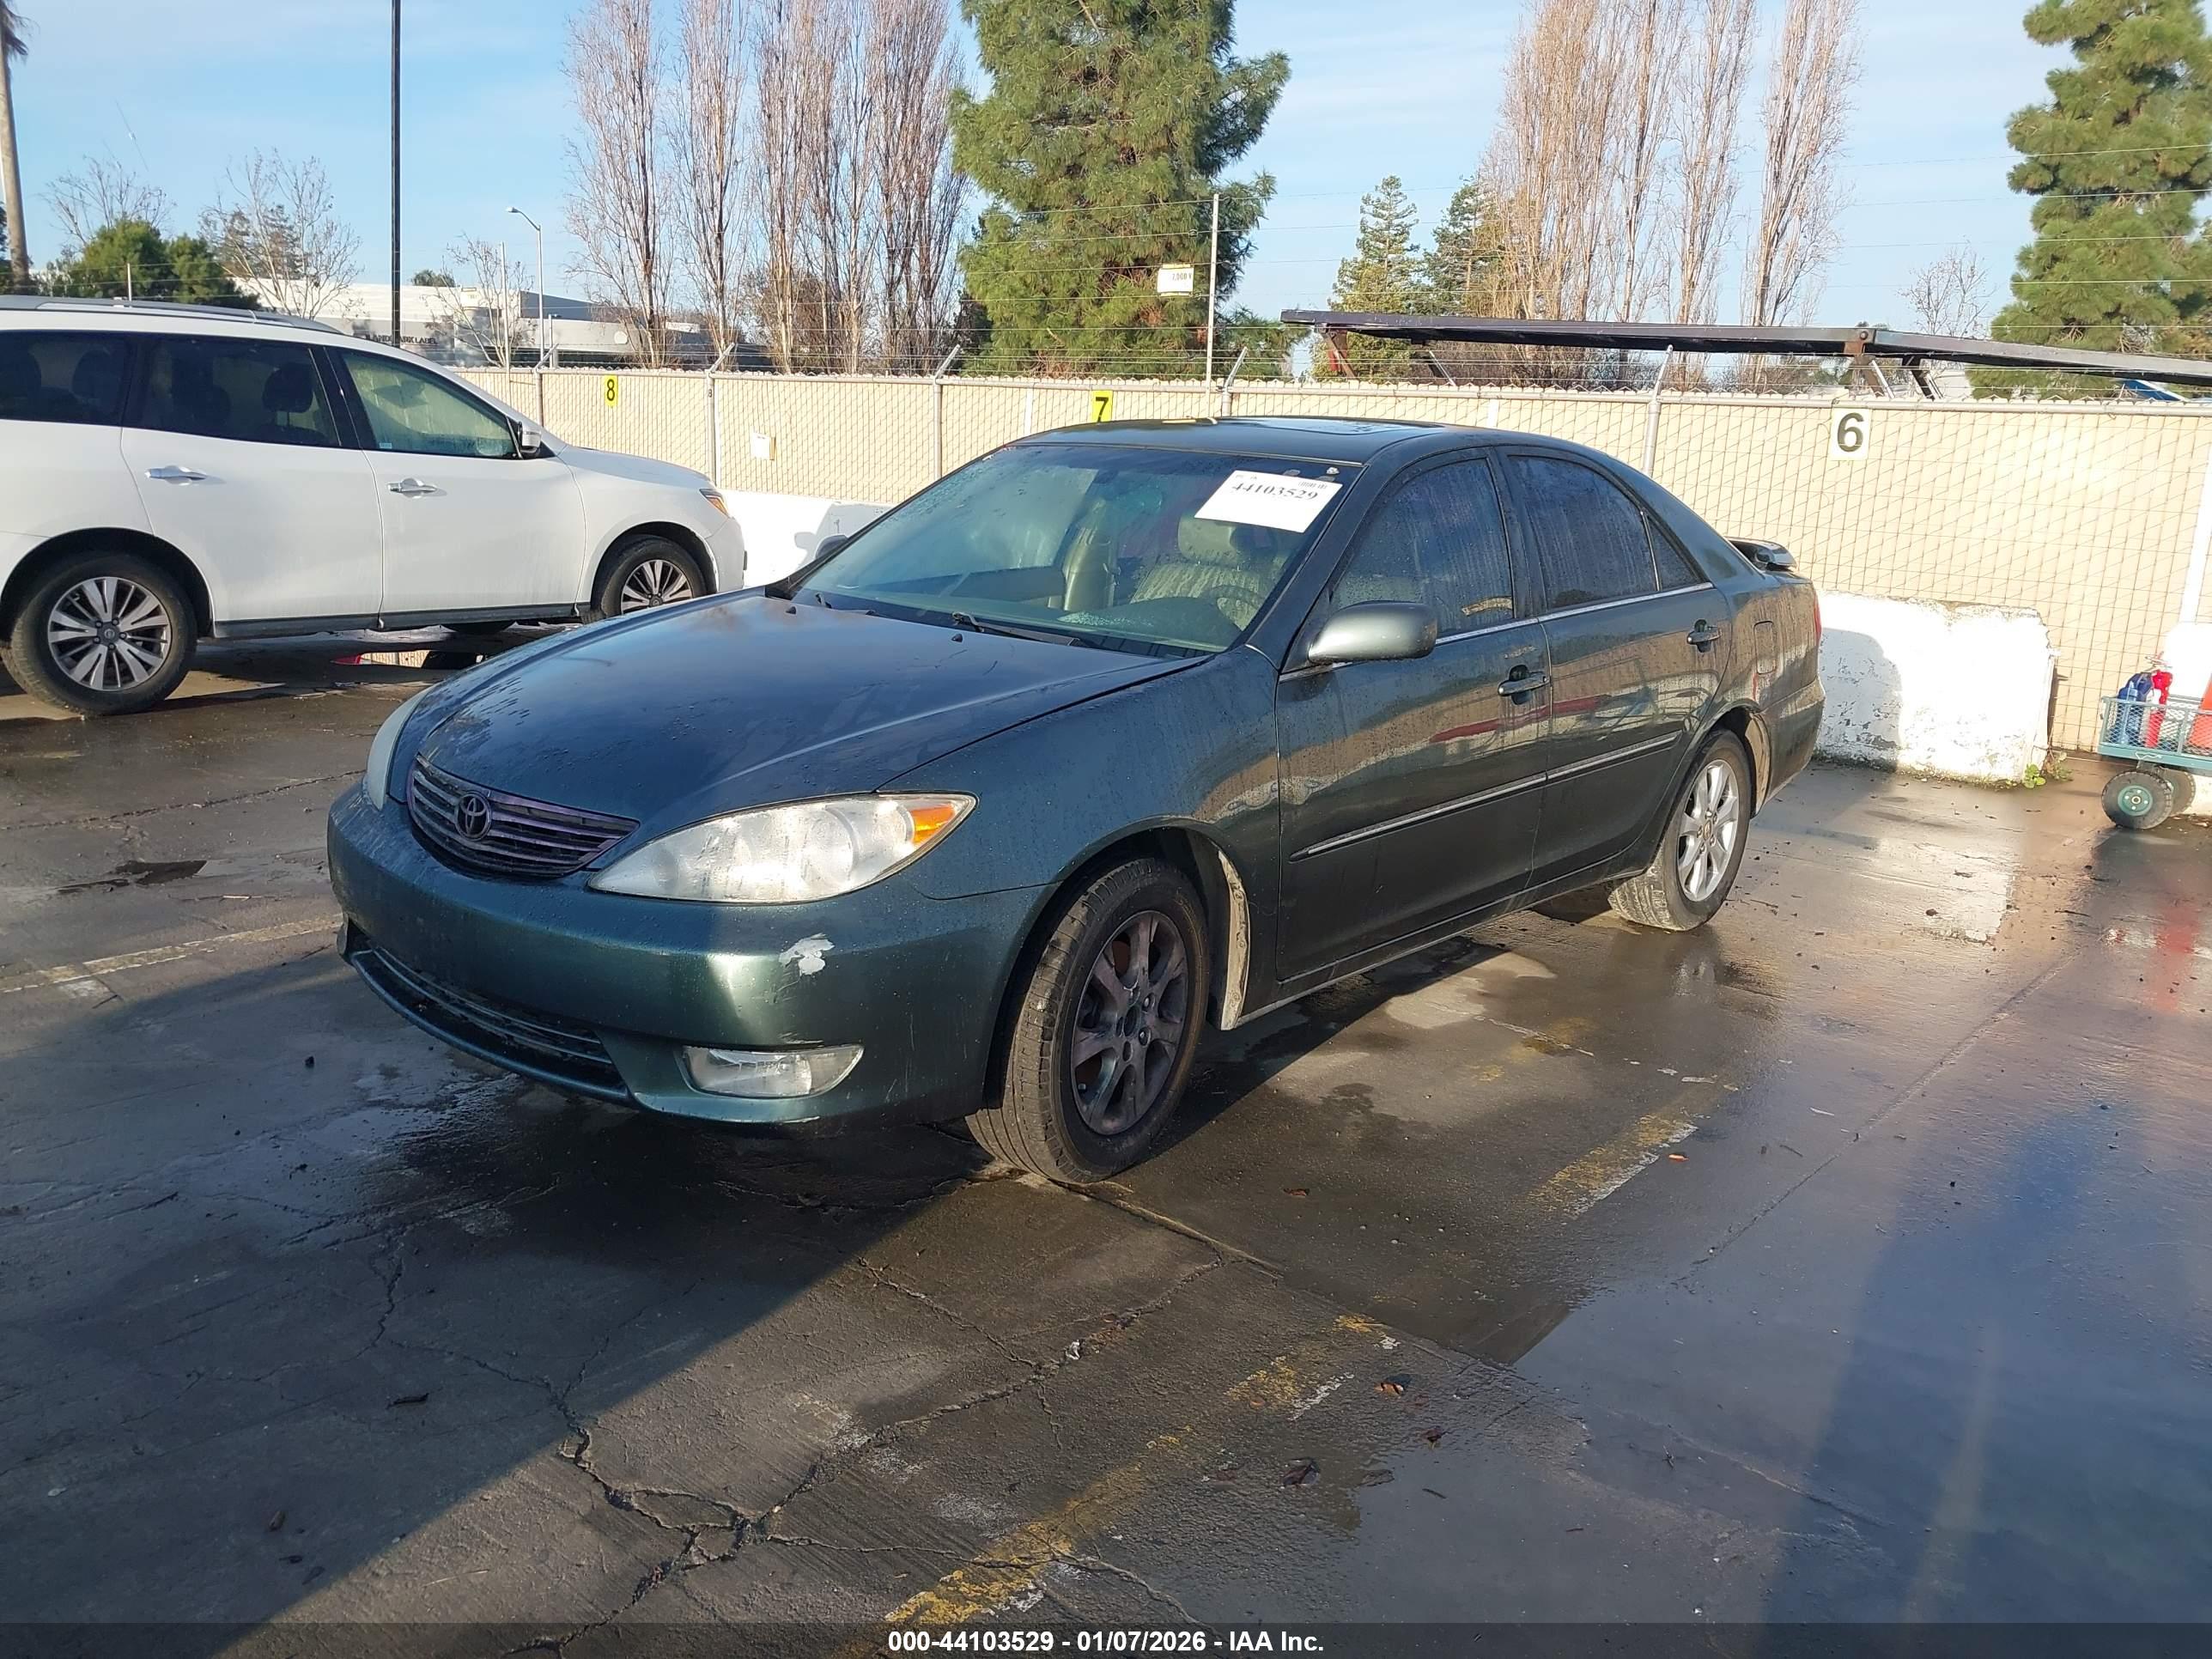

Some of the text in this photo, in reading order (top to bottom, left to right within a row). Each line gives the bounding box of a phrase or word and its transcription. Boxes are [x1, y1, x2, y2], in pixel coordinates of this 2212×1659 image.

[368, 333, 415, 343] LANDARK
[606, 379, 616, 402] 8
[1095, 396, 1109, 422] 7
[1837, 411, 1864, 453] 6
[1232, 482, 1318, 501] 44103529
